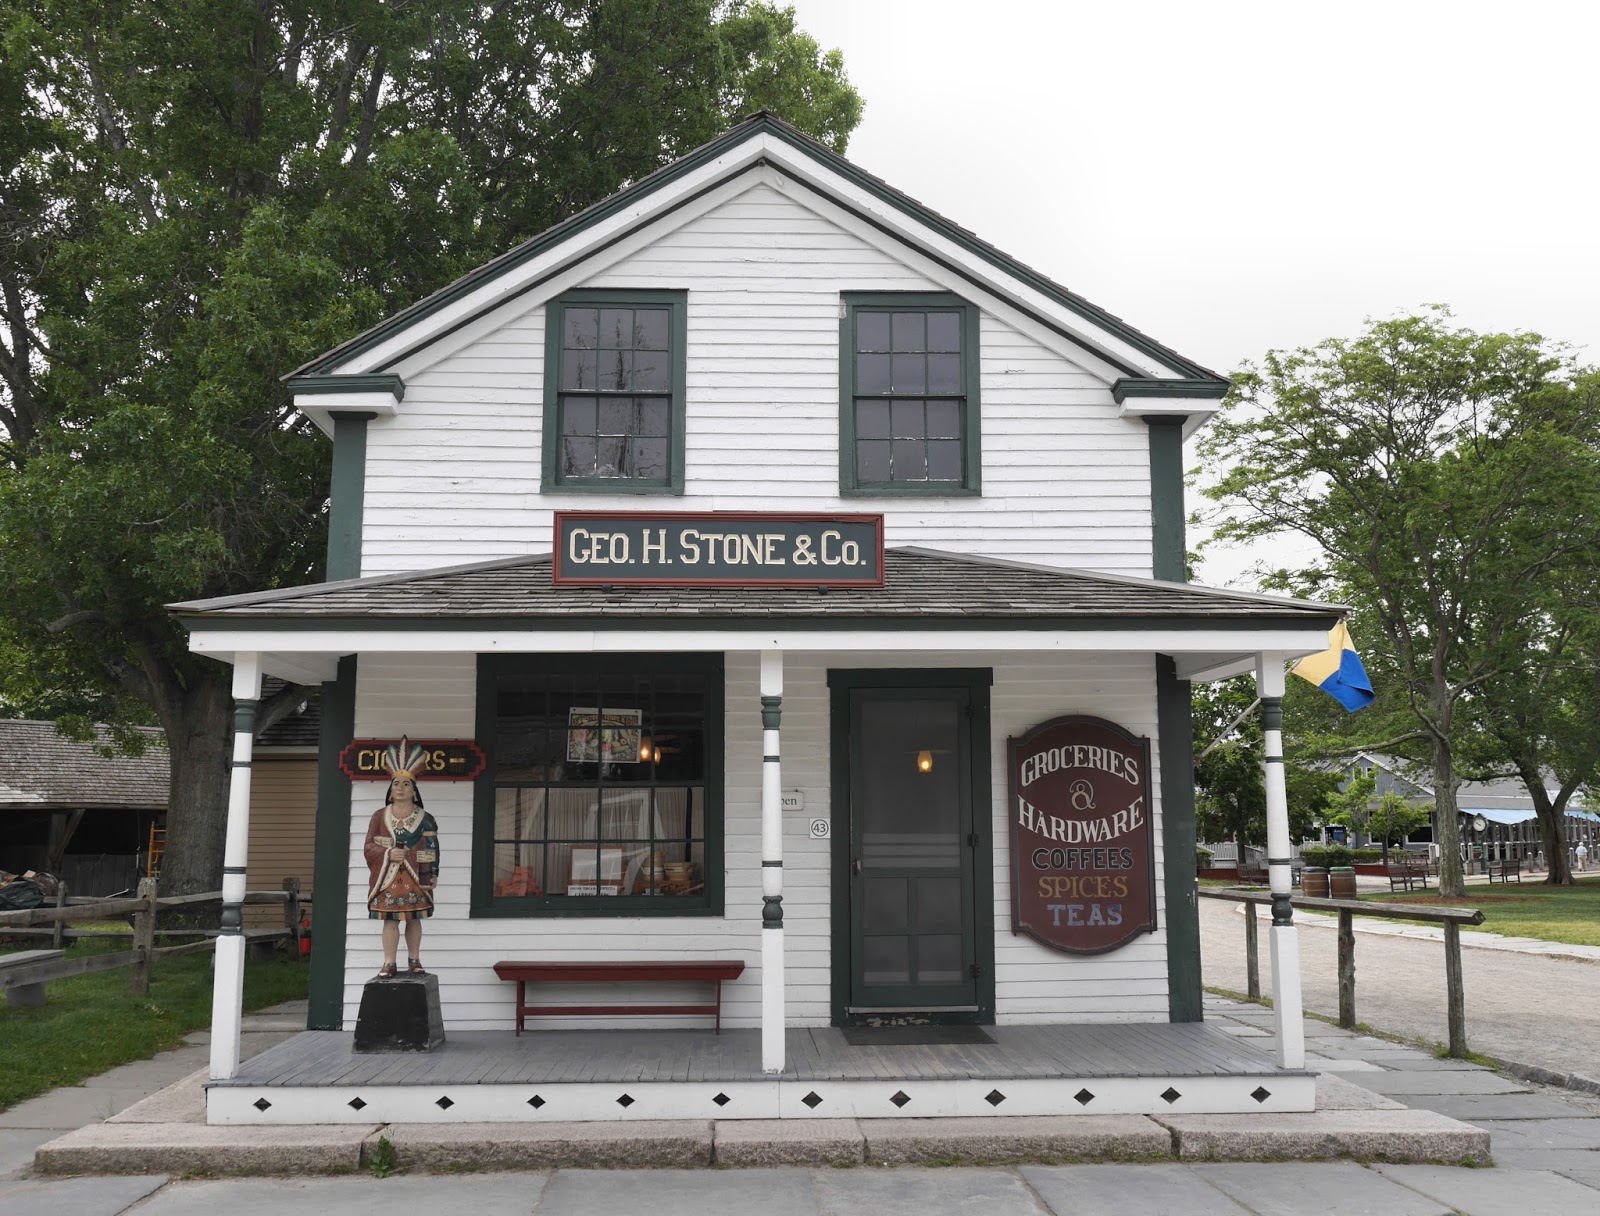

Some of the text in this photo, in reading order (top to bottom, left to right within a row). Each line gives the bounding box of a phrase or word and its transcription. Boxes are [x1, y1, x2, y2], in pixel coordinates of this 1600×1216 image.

[642, 528, 673, 564] H.
[679, 529, 786, 565] STONE
[792, 534, 818, 565] &
[1021, 744, 1140, 787] GROCERIES
[1069, 779, 1096, 811] &
[813, 823, 826, 833] 43
[1018, 794, 1144, 844] HARDWARE
[1032, 847, 1134, 870] COFFEES
[1038, 876, 1129, 899] SPICES
[1046, 903, 1123, 926] TEAS
